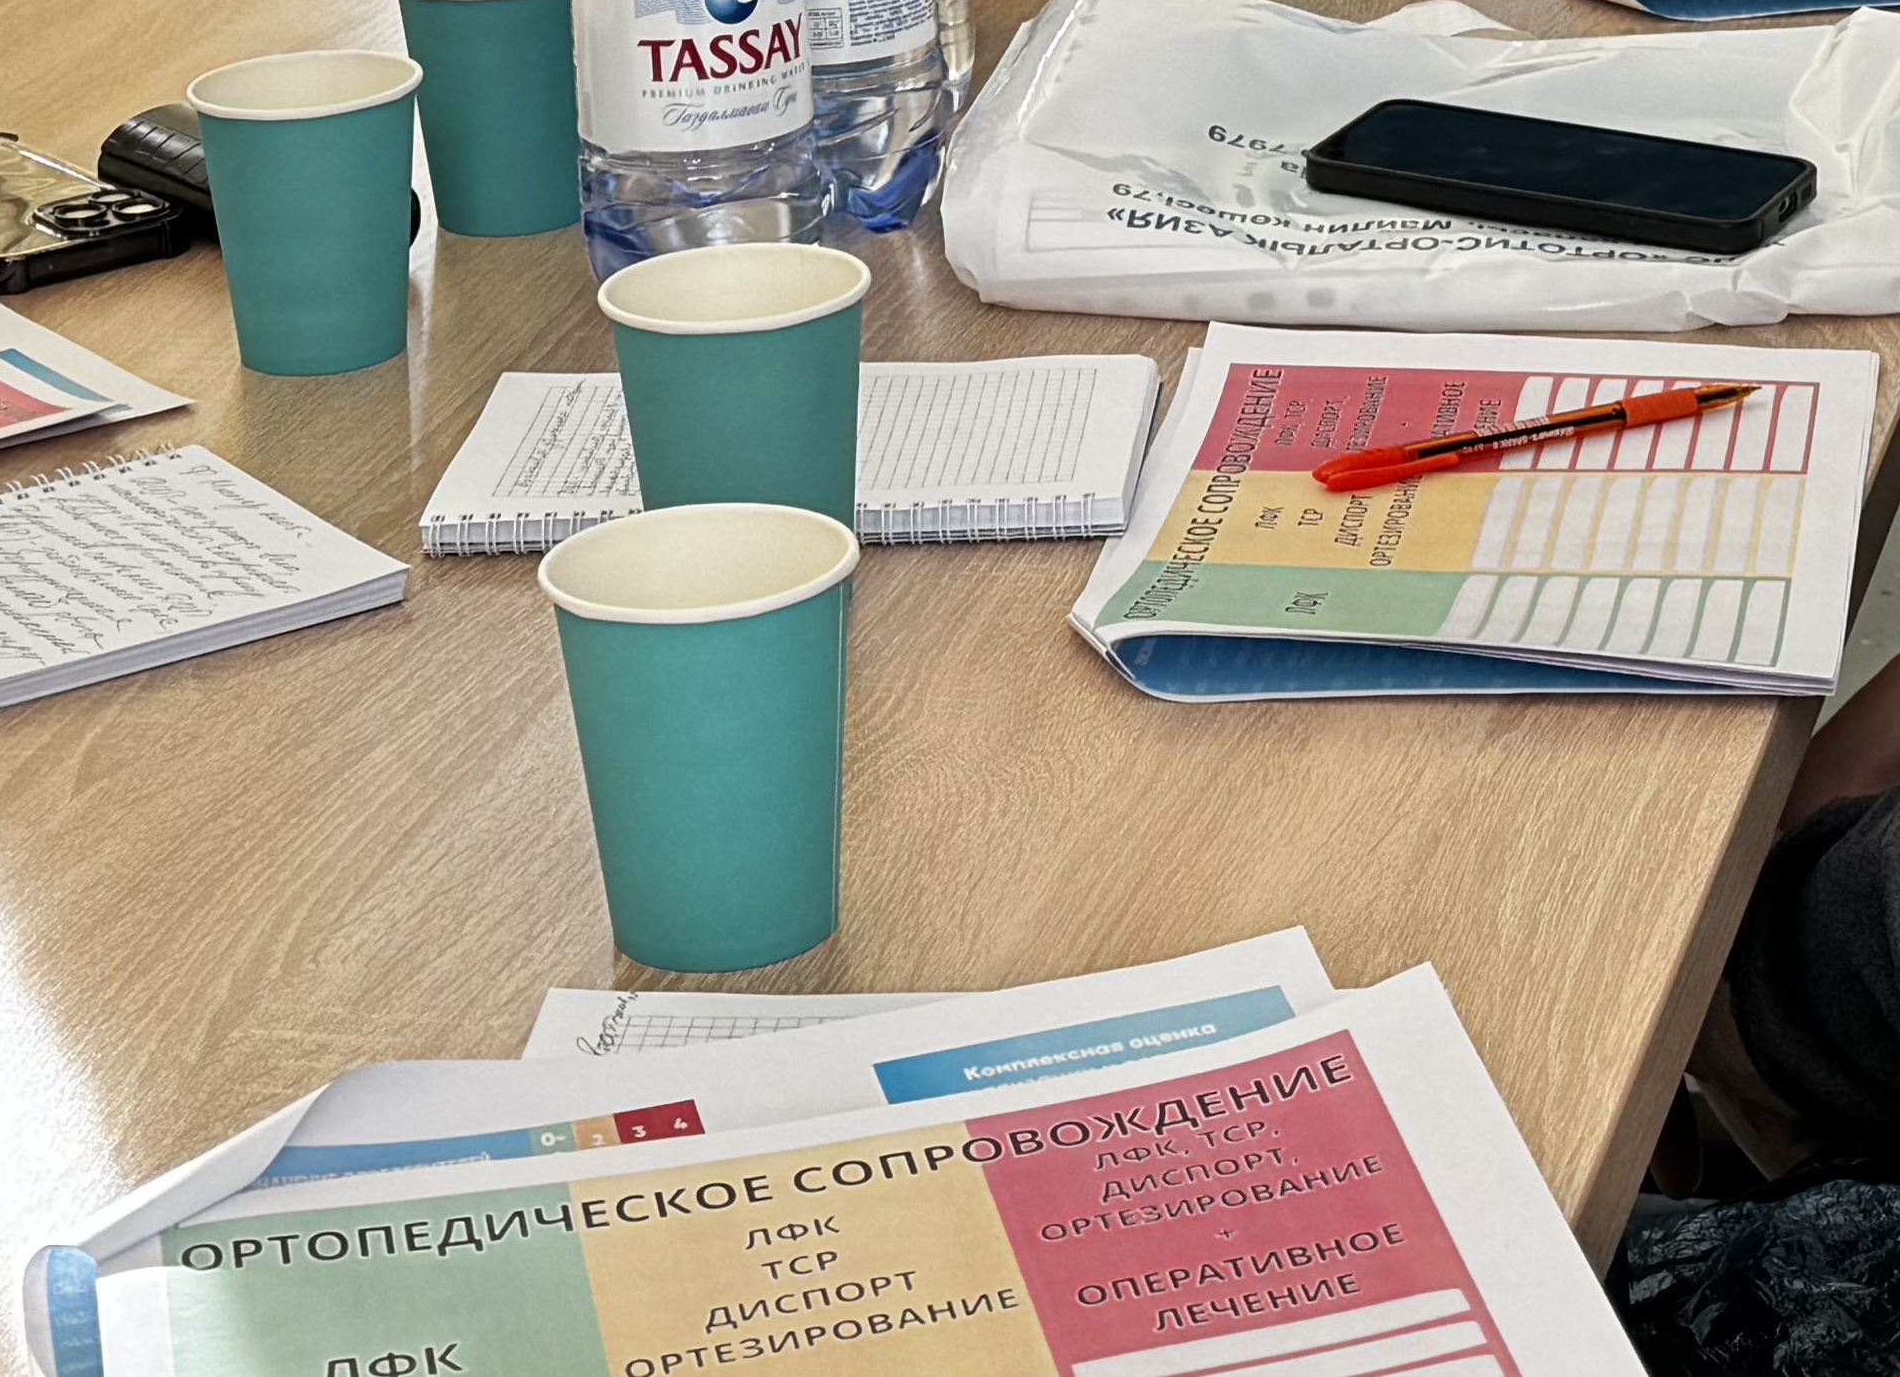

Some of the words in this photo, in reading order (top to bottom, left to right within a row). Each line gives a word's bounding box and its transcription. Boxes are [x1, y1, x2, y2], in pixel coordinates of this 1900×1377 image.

[637, 12, 803, 82] TASSAY
[1106, 207, 1235, 239] АЗИЯ»
[1431, 382, 1466, 439] АТИВНОЕ
[1123, 516, 1224, 620] ОРТОПЕДИЧЕСКОЕ
[1196, 368, 1283, 515] СОПРОВОЖДЕНИЕ
[1255, 506, 1284, 530] ЛФК
[1298, 508, 1324, 528] ТСР
[1334, 493, 1372, 547] ДИСПОРТ
[1285, 591, 1329, 616] ЛФК
[963, 1038, 1125, 1083] Комплексная
[1129, 1020, 1218, 1051] оценка
[180, 1173, 774, 1273] ОРТОПЕДИЧЕСКОЕ
[792, 1053, 1354, 1194] СОПРОВОЖДЕНИЕ
[1092, 1138, 1190, 1171] ЛФК,
[1198, 1118, 1280, 1150] ТСР,
[1039, 1154, 1383, 1243] ОРТЕЗИРОВАНИЕ
[1099, 1147, 1300, 1204] ДИСПОРТ,
[744, 1214, 841, 1251] ЛФК
[760, 1249, 840, 1281] ТСР
[1076, 1221, 1406, 1307] ОПЕРАТИВНОЕ
[703, 1270, 919, 1334] ДИСПОРТ
[1152, 1272, 1362, 1333] ЛЕЧЕНИЕ
[323, 1343, 464, 1377] ЛФК
[624, 1288, 1022, 1377] ОРТЕЗИРОВАНИЕ
